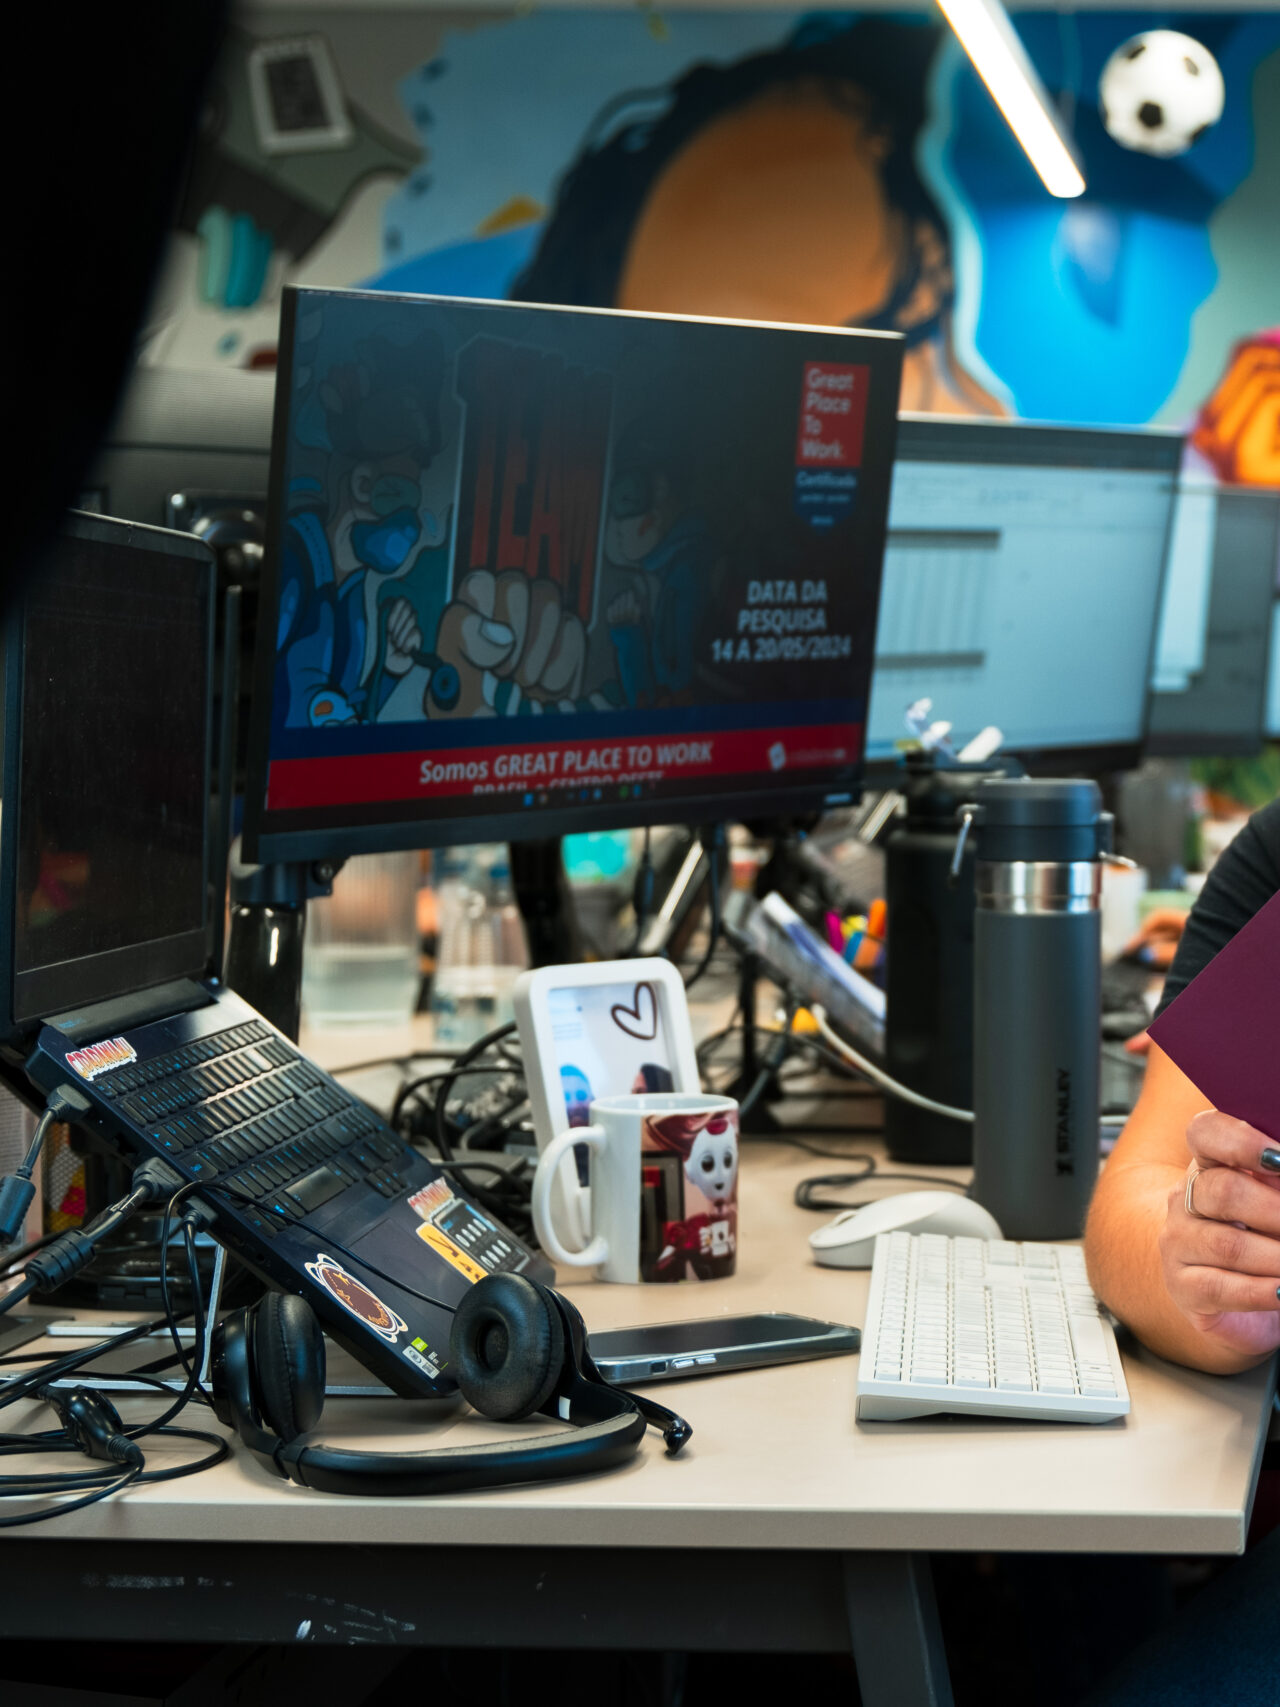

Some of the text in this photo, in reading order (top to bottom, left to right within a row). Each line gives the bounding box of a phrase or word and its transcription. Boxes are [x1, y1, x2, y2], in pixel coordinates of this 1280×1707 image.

[807, 368, 854, 390] Great
[805, 391, 851, 413] Place
[804, 414, 823, 435] To
[748, 579, 828, 604] DATA DA
[737, 608, 827, 635] PESQUISA
[711, 638, 734, 663] 14
[735, 638, 751, 662] A
[420, 741, 714, 784] Somos GREAT PLACE TO WORK
[1057, 1068, 1071, 1155] STANLEY
